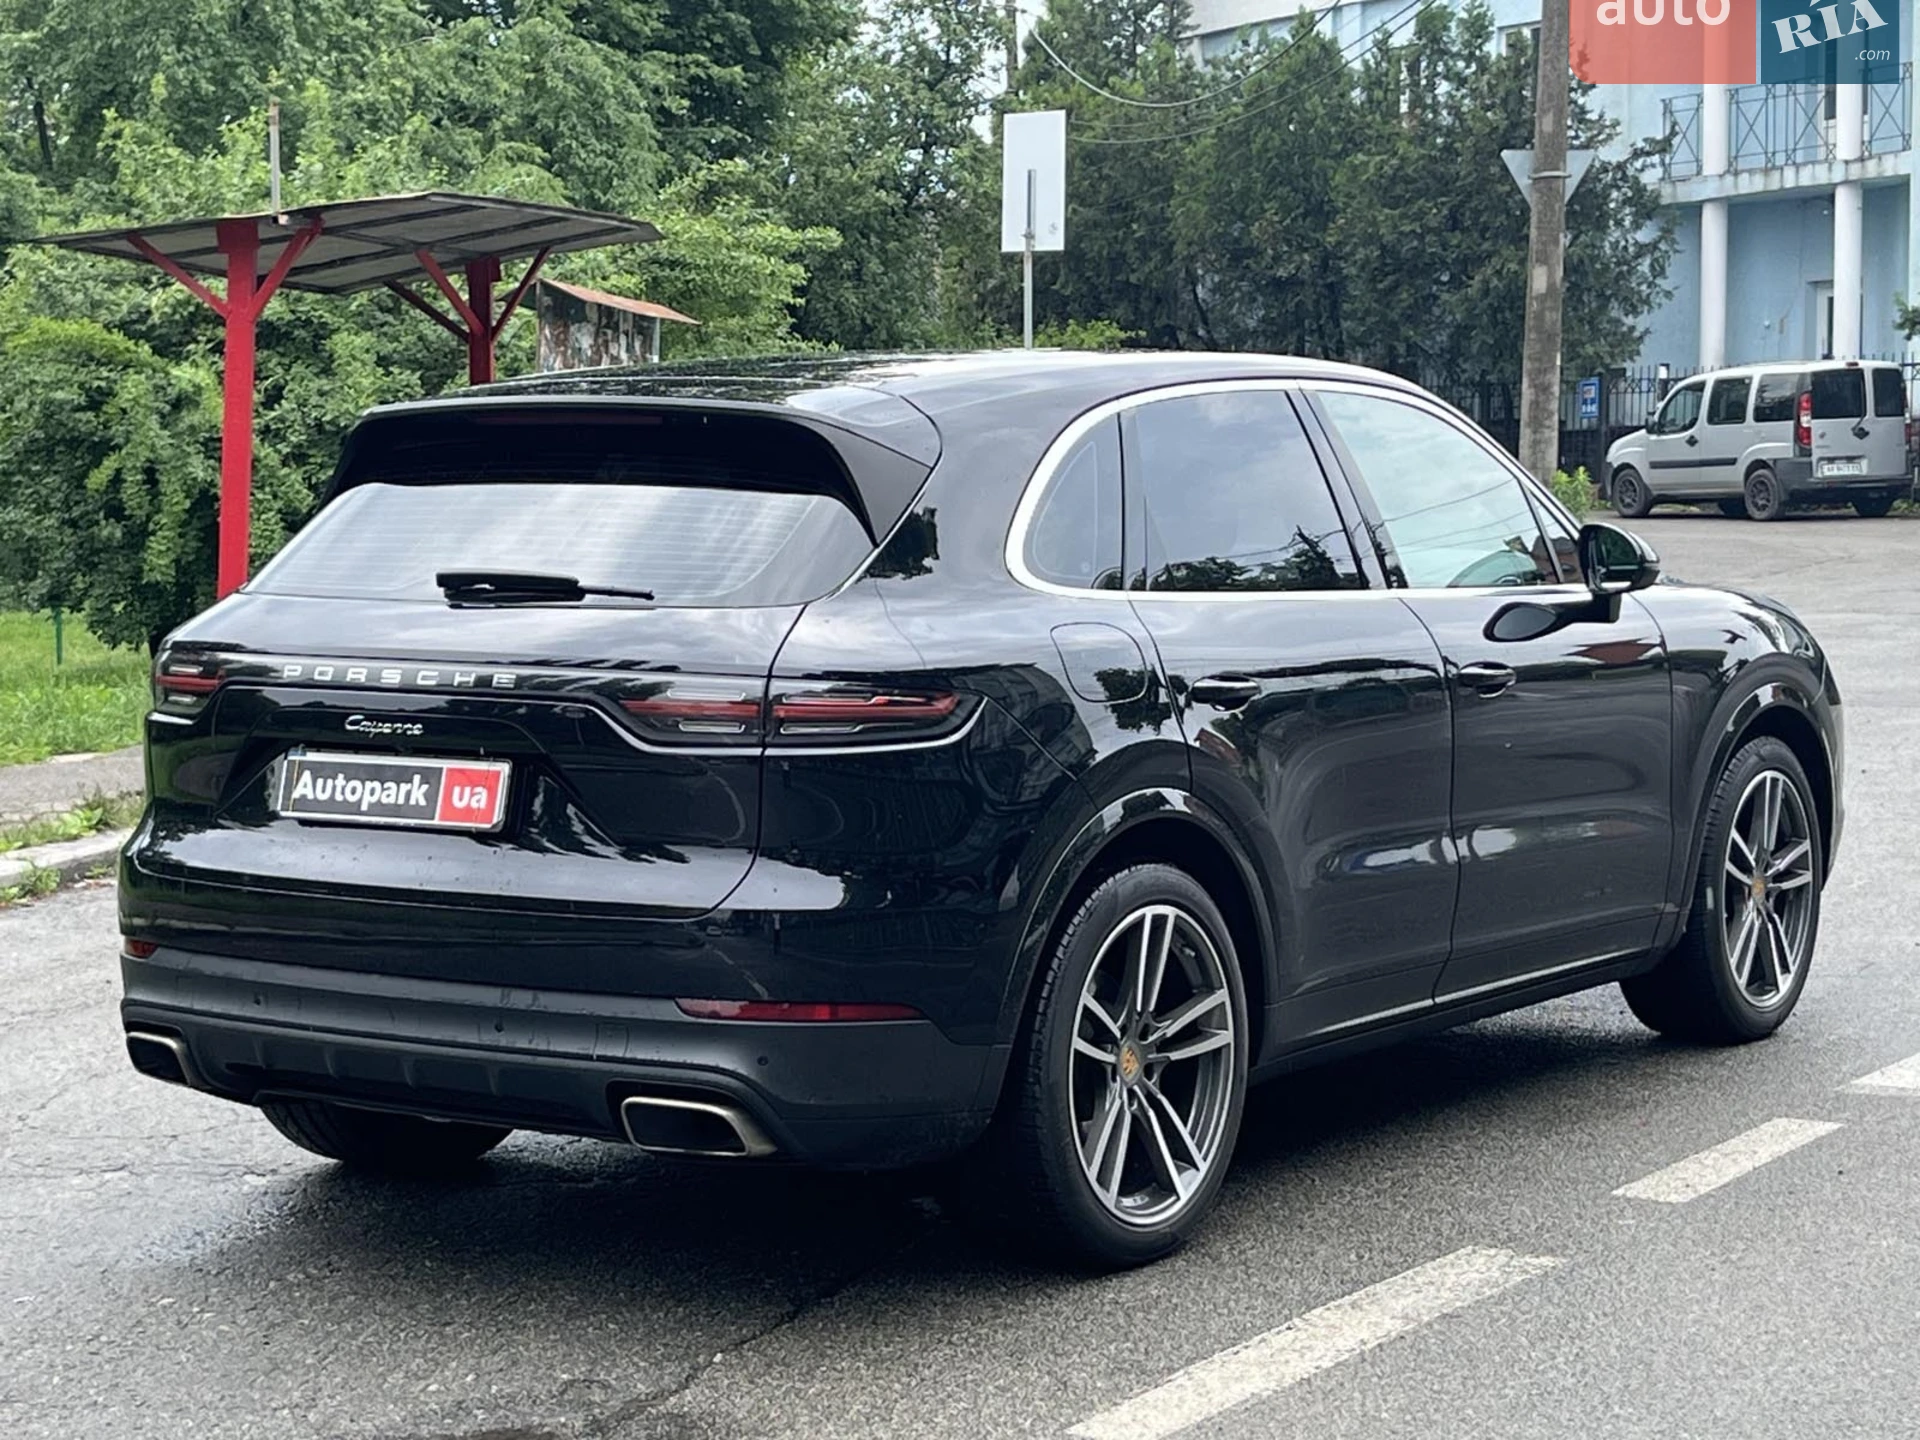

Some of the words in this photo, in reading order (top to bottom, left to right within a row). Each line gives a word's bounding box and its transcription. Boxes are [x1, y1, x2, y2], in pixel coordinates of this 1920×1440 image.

[282, 664, 517, 688] PORSCHE
[293, 769, 430, 812] Autopark
[451, 784, 489, 810] ua
